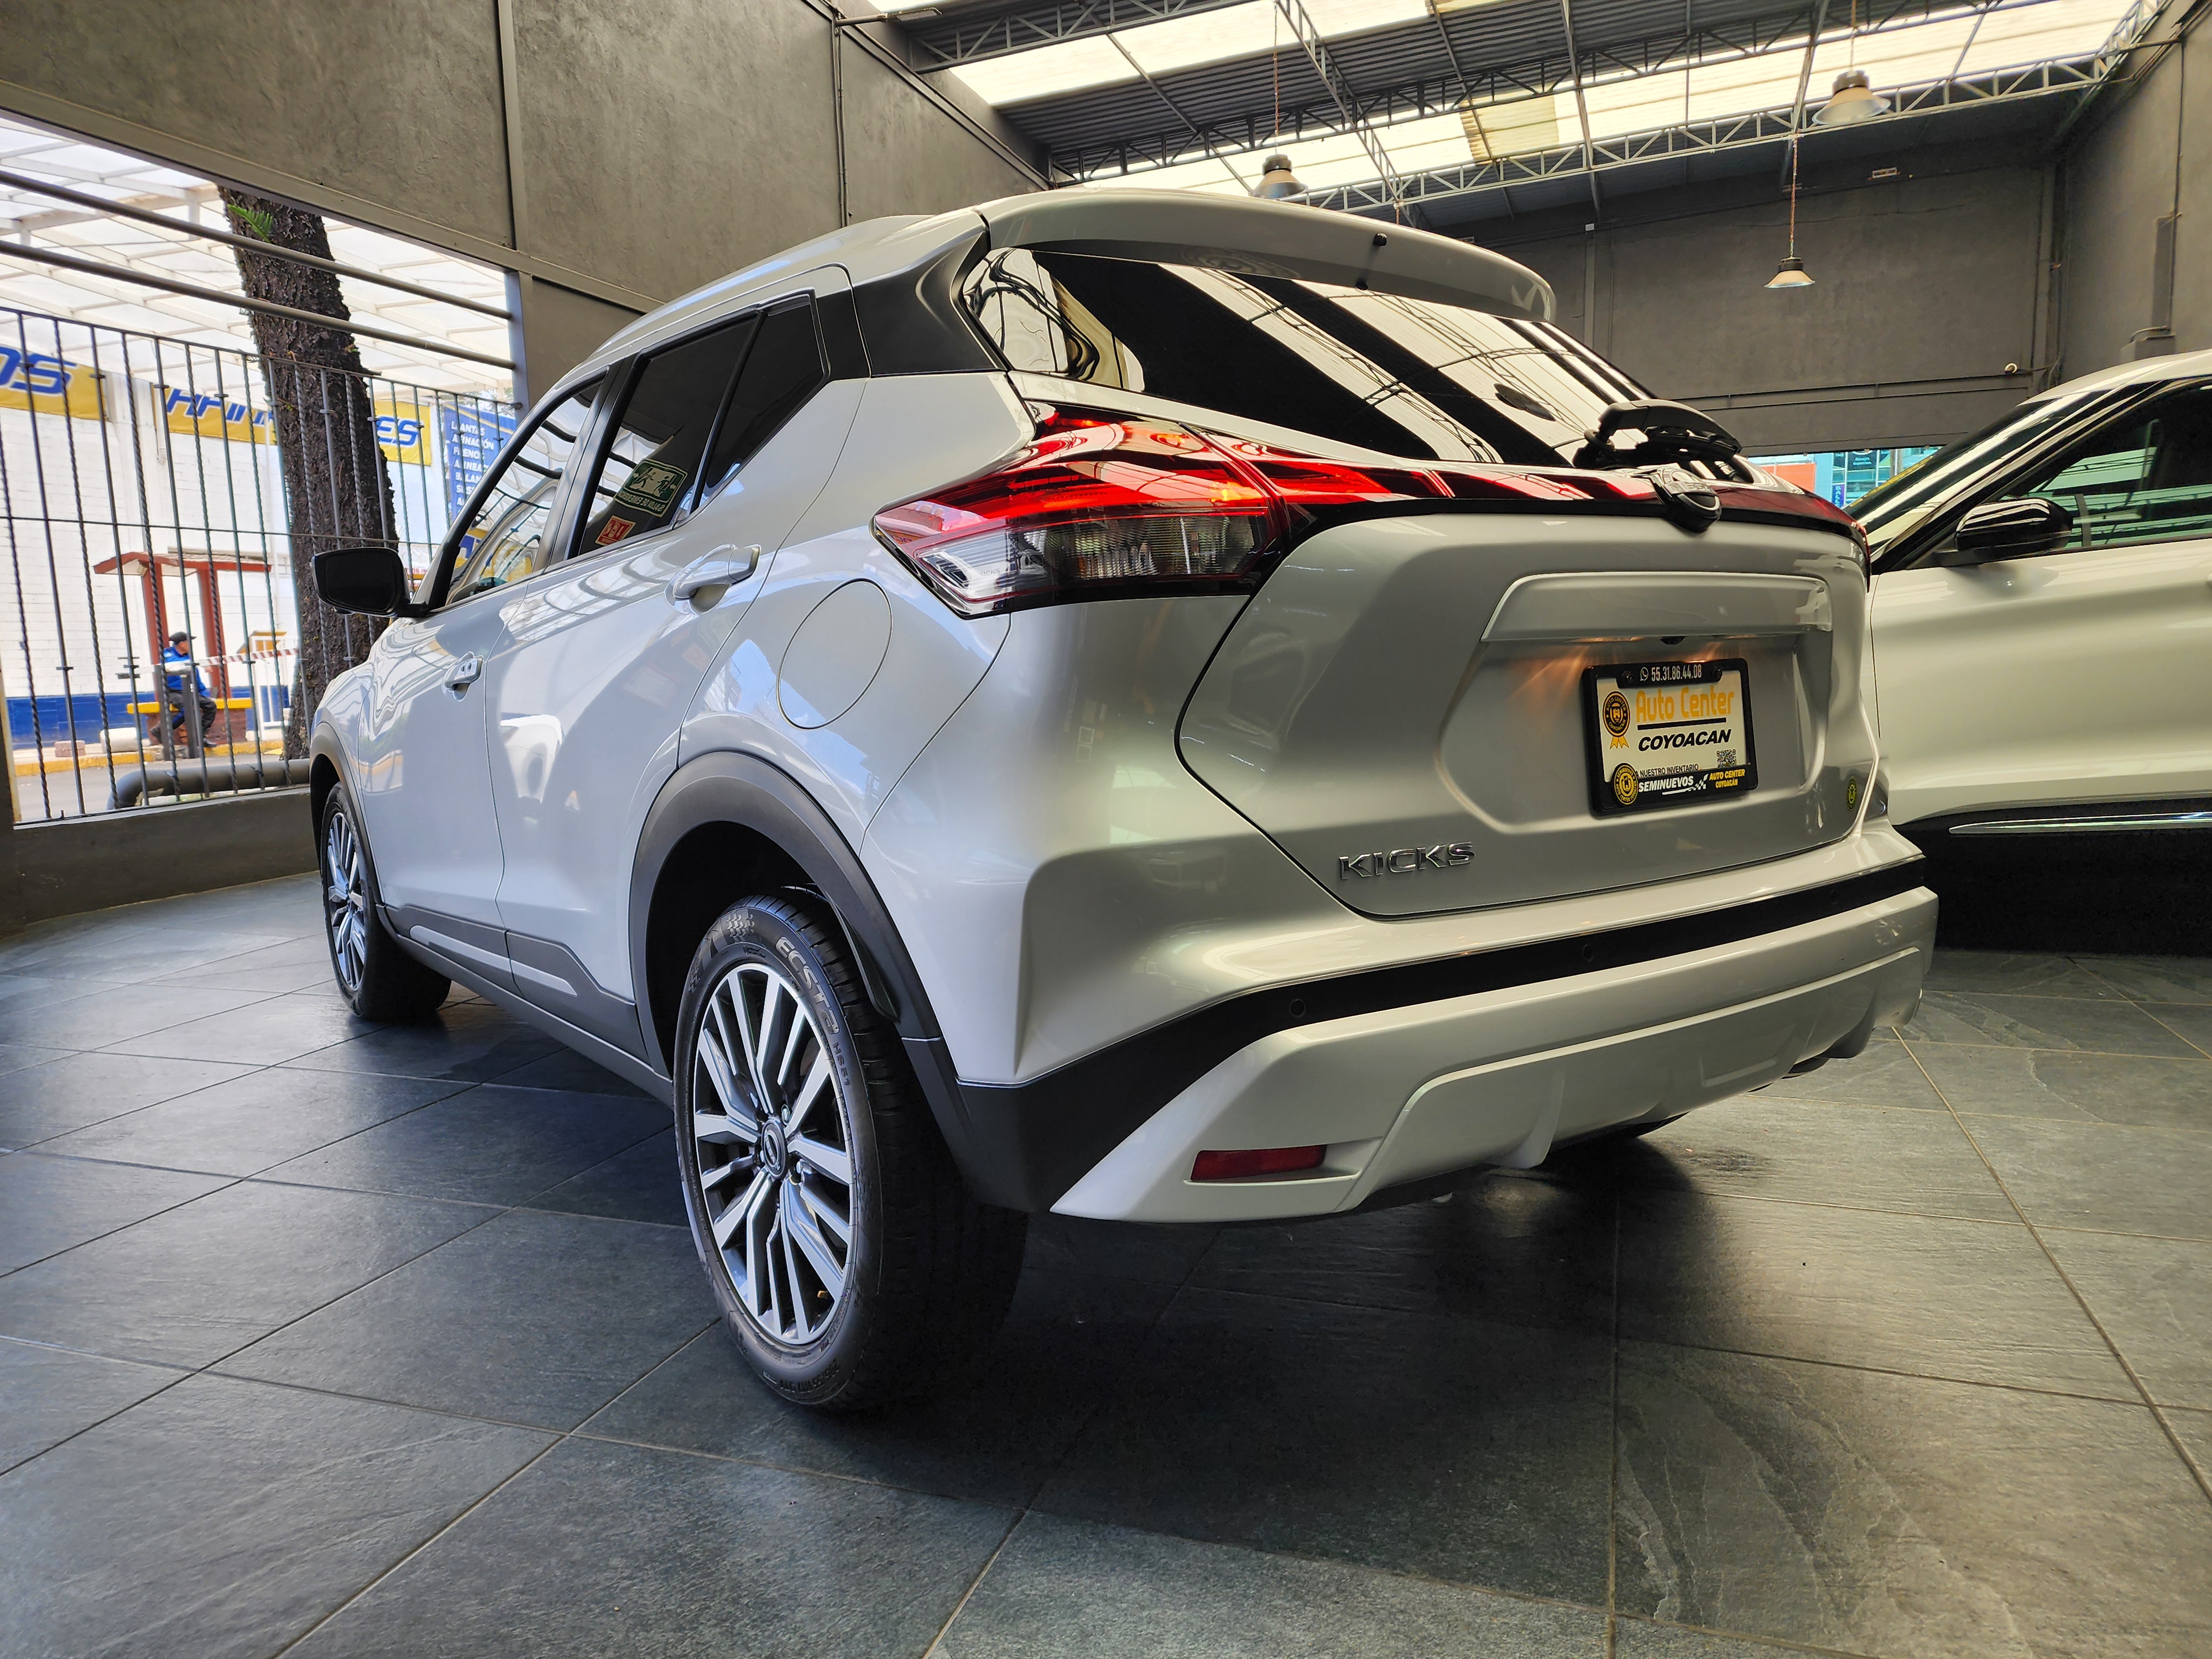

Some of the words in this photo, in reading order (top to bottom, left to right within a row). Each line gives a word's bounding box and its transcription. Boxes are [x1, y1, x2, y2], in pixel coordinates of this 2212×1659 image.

[451, 420, 486, 436] LANTAS
[452, 434, 494, 451] AINACÓN
[453, 446, 486, 460] FENO
[1651, 664, 1702, 682] 55.31.86.44.08
[1636, 688, 1675, 723] Auto
[1680, 685, 1735, 718] Center
[1638, 729, 1732, 752] COYOACAN
[1640, 767, 1666, 778] NUESTRO
[1667, 763, 1699, 774] INVENTARIO
[1709, 770, 1723, 781] AUTO
[1724, 769, 1745, 779] CENTER
[1638, 775, 1694, 793] SEMINUEVOS
[1338, 841, 1476, 880] KICKS
[832, 1041, 851, 1086] HS51
